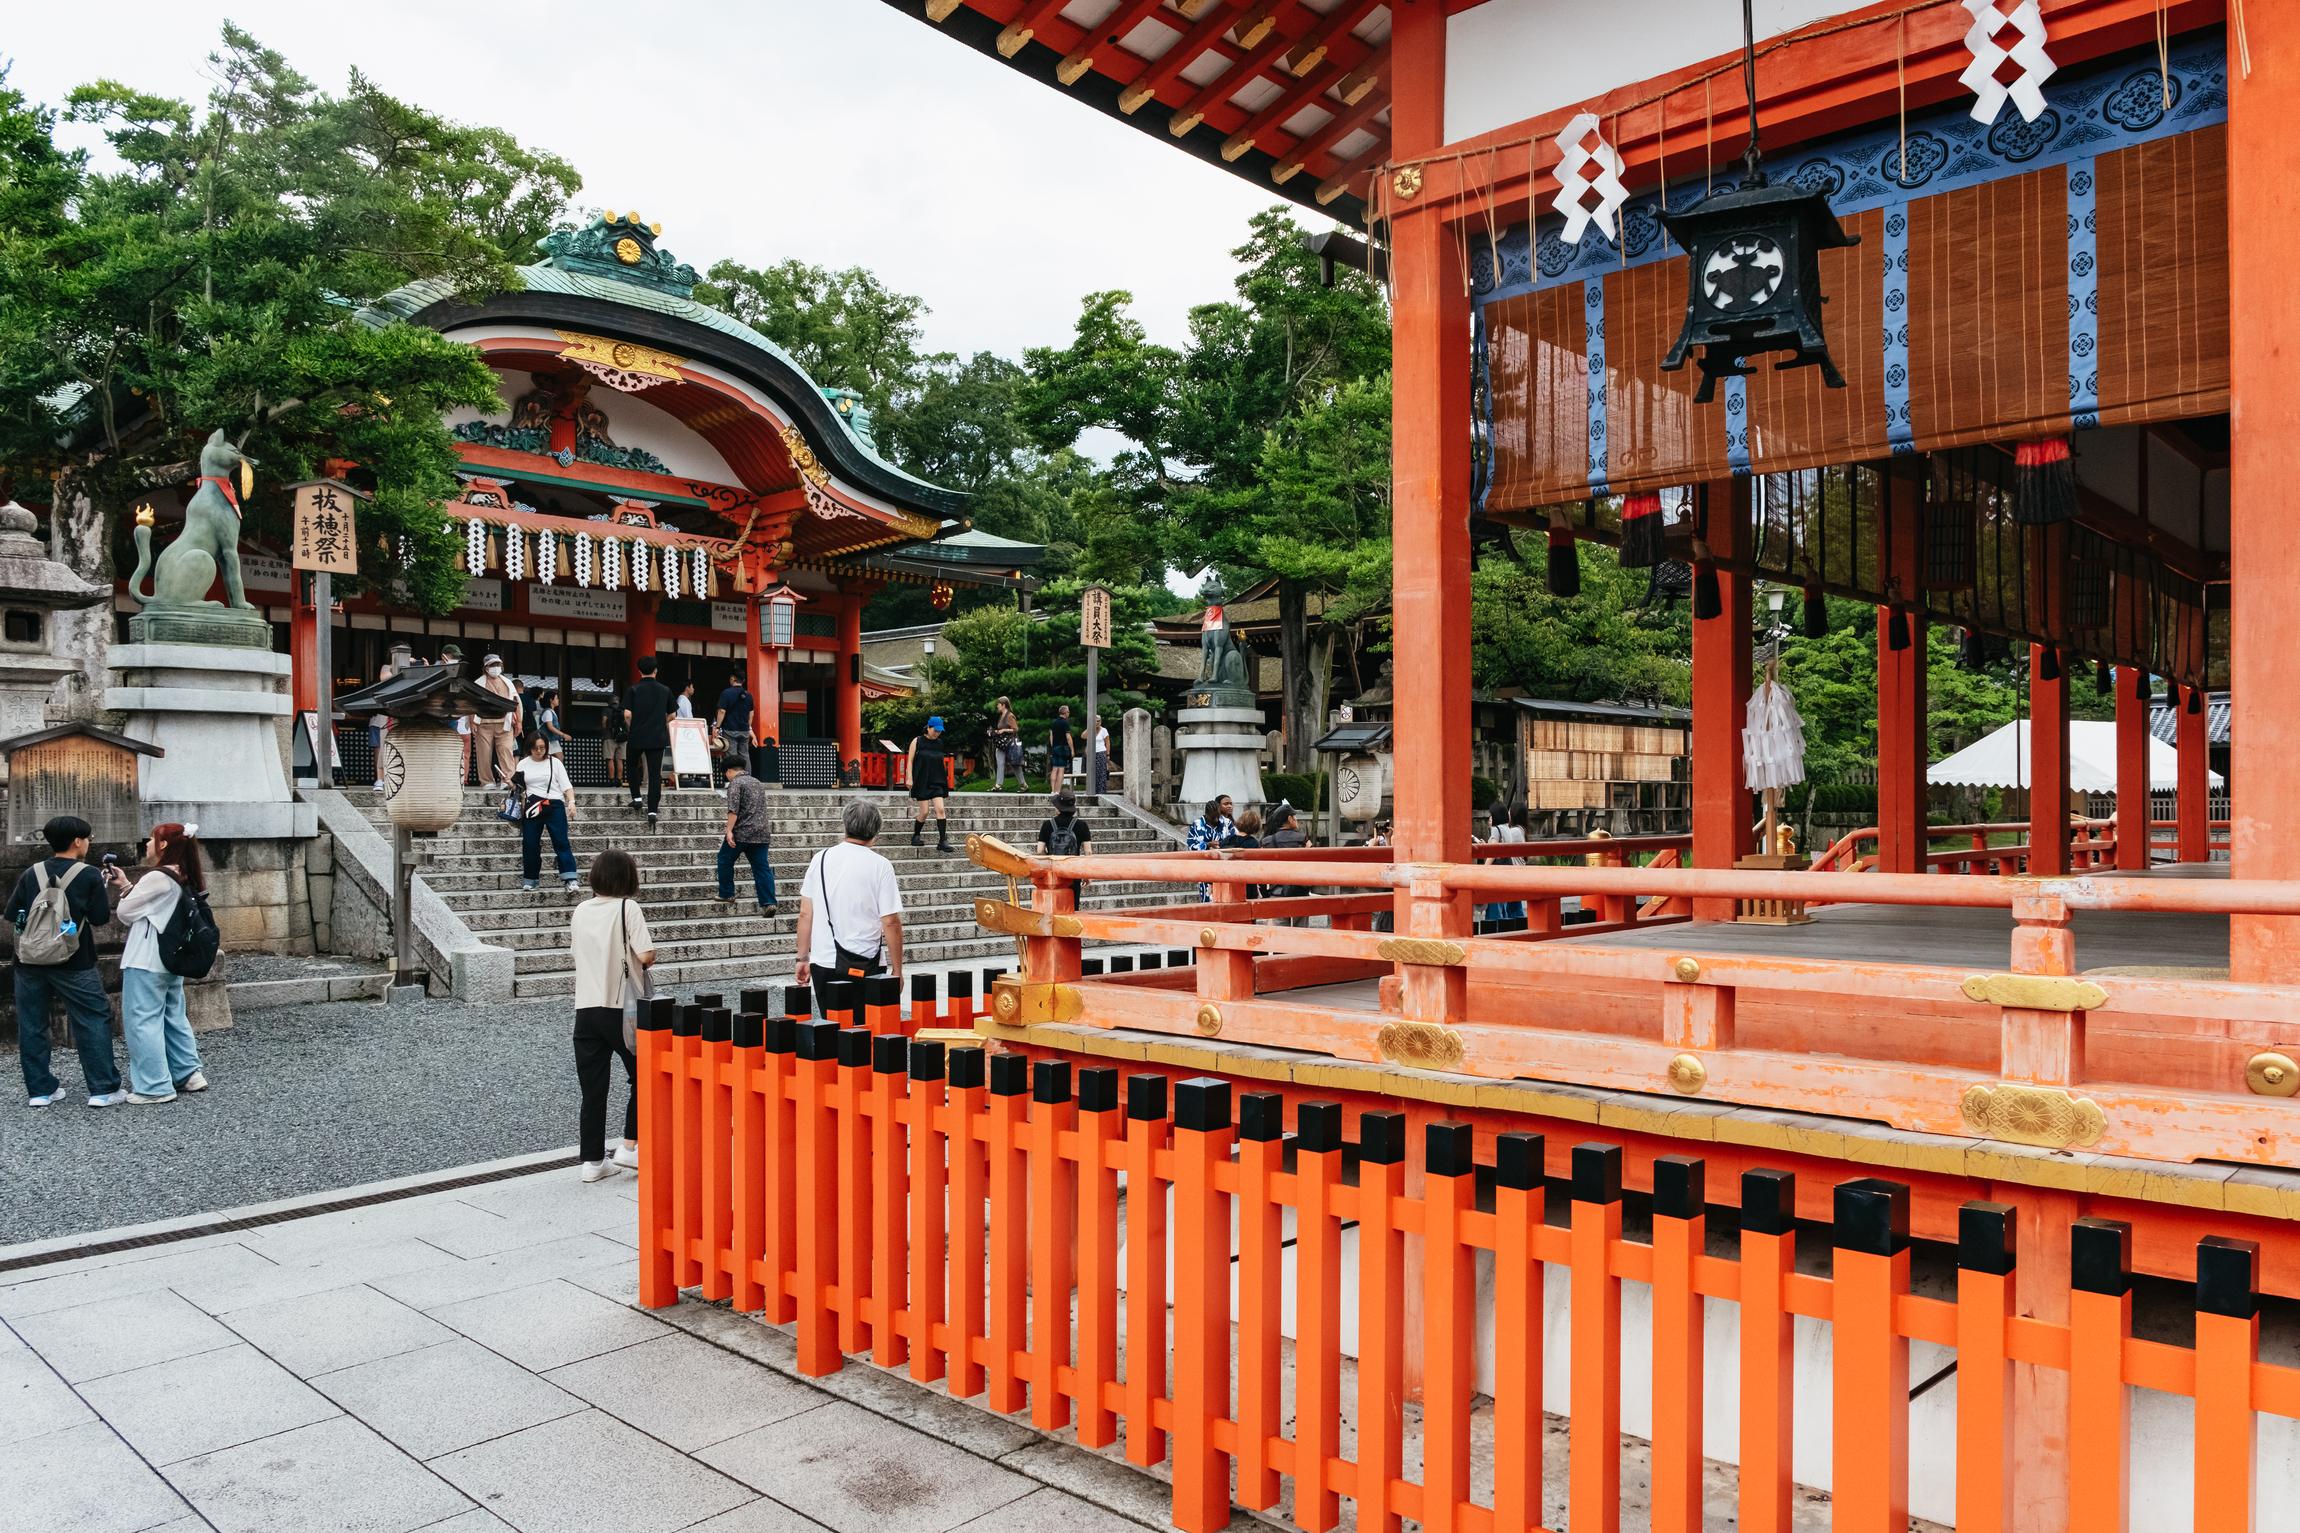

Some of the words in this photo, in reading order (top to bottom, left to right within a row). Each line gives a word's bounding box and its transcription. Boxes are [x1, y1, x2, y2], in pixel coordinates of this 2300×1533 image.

[301, 515, 310, 559] 午前十一時
[312, 487, 342, 564] 抜穂祭
[341, 512, 350, 560] 十月二十五日
[1092, 590, 1103, 645] 講員大祭
